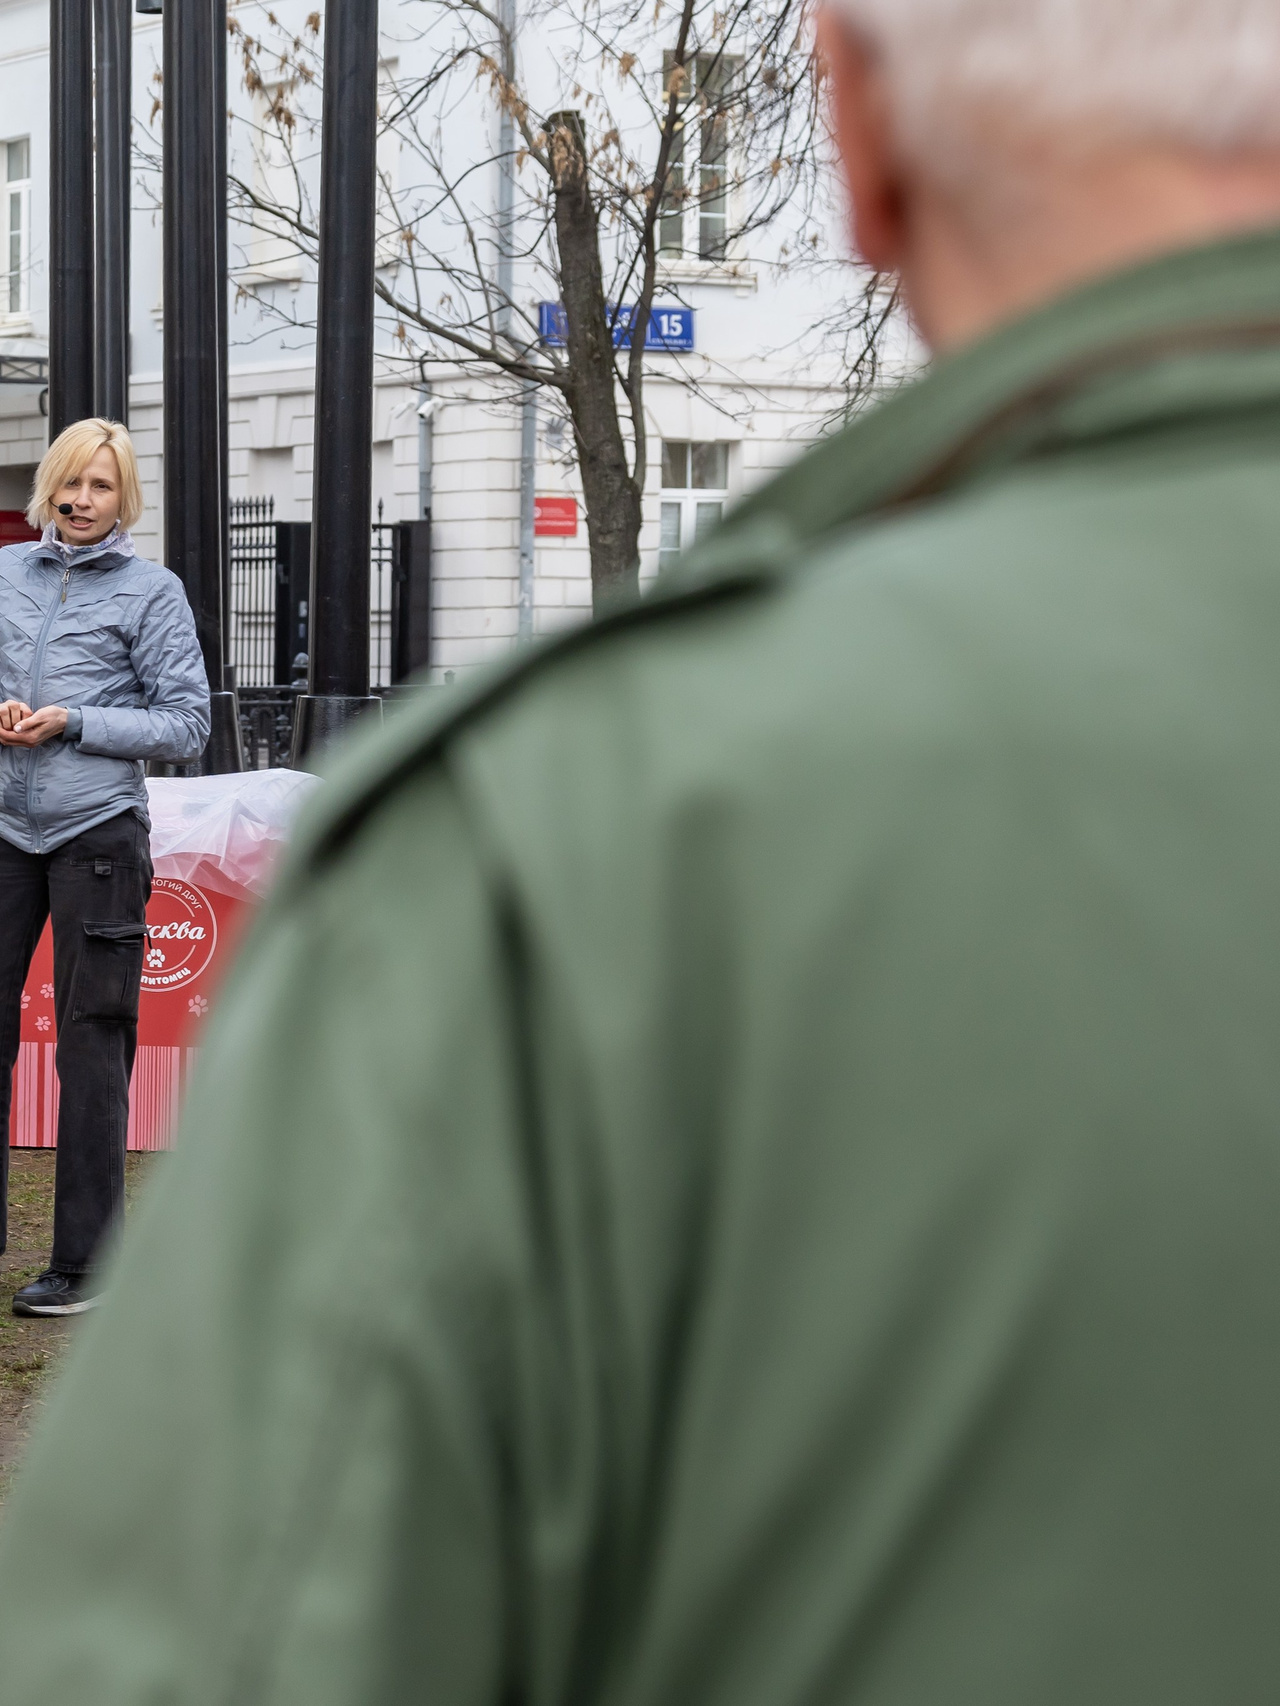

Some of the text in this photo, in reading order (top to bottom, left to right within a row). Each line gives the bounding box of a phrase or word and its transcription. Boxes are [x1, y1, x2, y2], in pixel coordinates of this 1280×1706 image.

[659, 314, 683, 337] 15
[181, 889, 203, 909] ДРУГ
[146, 921, 206, 940] сква
[140, 967, 191, 985] ПИТОМЕЦ
